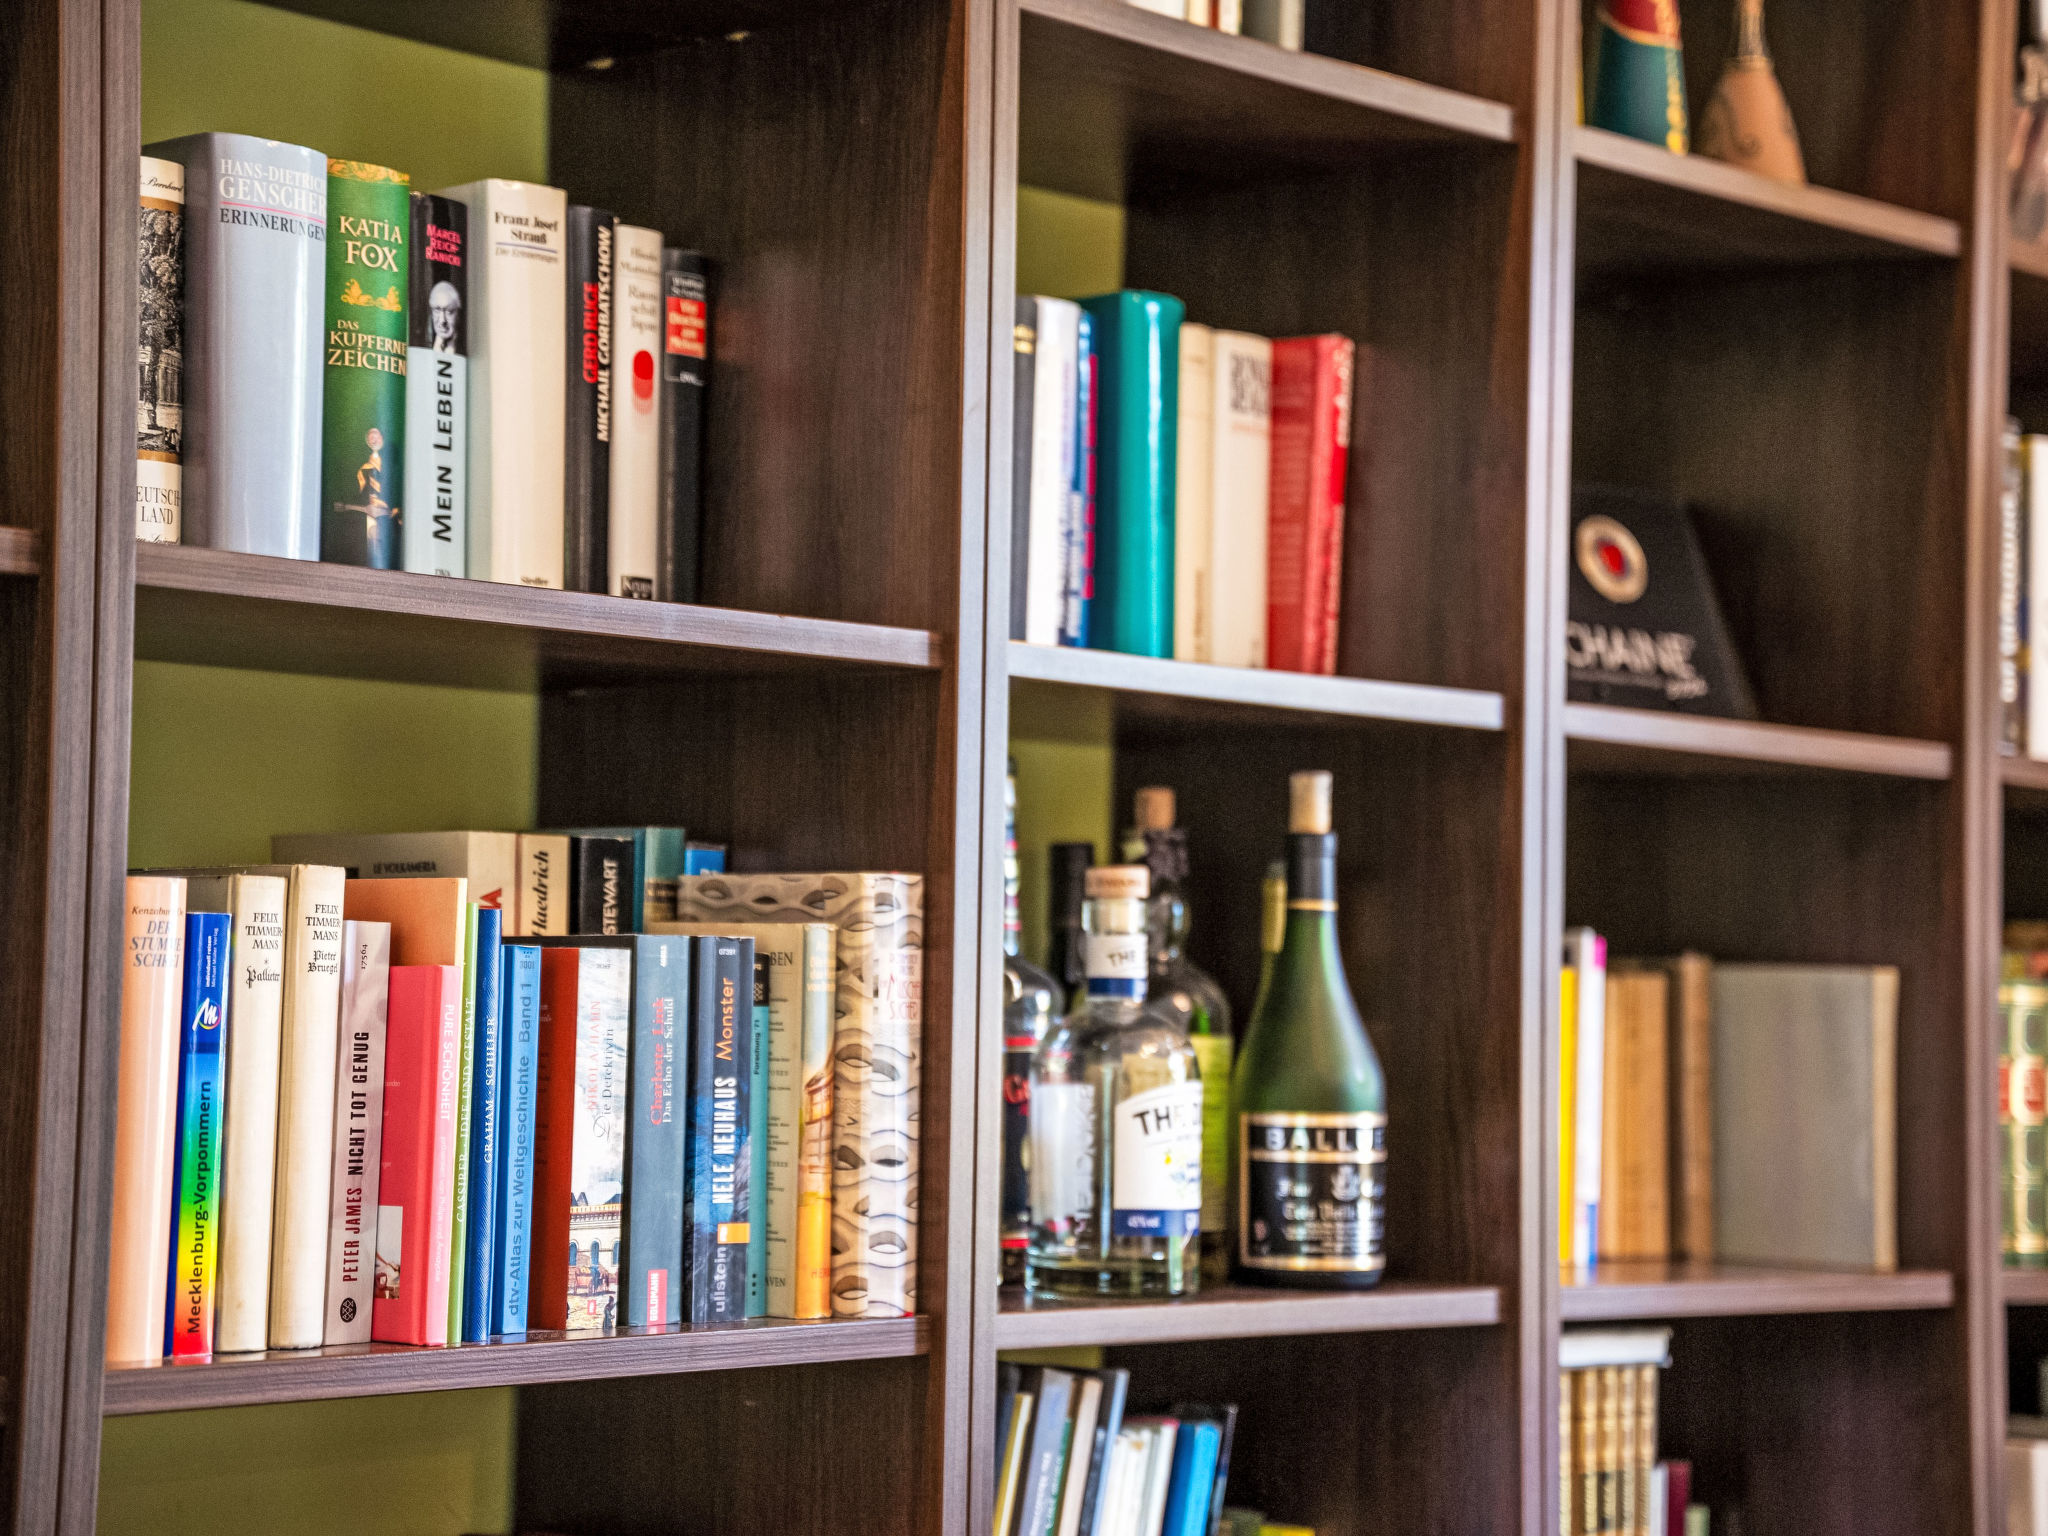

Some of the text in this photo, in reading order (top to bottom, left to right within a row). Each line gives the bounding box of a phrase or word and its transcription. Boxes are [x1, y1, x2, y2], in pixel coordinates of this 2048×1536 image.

[219, 176, 327, 217] GENSCHER
[219, 207, 326, 242] ERINNERUNGEN
[339, 215, 403, 244] KATIA
[426, 223, 461, 245] MARCEL
[494, 211, 559, 232] Franz Josef
[510, 229, 547, 245] Strauß
[345, 240, 398, 272] FOX
[330, 330, 407, 357] KUPFERNE
[337, 319, 359, 335] DAS
[583, 281, 599, 384] GERD RUGE
[597, 226, 612, 442] MICHAIL GORBATSCHOW
[328, 348, 406, 376] ZEICHEN
[433, 358, 454, 542] MEIN LEBEN
[136, 485, 180, 507] EUTSCH
[141, 505, 174, 525] LAND
[131, 905, 174, 916] Kenzabur
[315, 904, 339, 915] FELIX
[602, 856, 619, 936] STEWART
[253, 912, 279, 924] FELIX
[312, 930, 338, 941] MANS
[129, 936, 182, 951] STUME
[252, 939, 279, 950] MANS
[313, 950, 337, 963] Pieter
[769, 951, 793, 966] BEN
[715, 977, 735, 1061] Monster
[440, 1004, 455, 1120] PURE SCHÖNHEIT
[586, 1000, 600, 1110] NIKOLA HAHN
[602, 1028, 614, 1098] Detektivin
[650, 997, 664, 1126] Charlotte Link
[662, 998, 675, 1124] Das Echo der Schuld
[347, 1031, 370, 1176] NICHT TOT GENUG
[484, 1014, 496, 1163] GRAHAM SCHILLER
[456, 998, 475, 1222] CASSIRER IDEE UND GESTALT
[1132, 1104, 1172, 1136] TH
[508, 983, 532, 1316] dtv-Atlas zur Weltgeschichte Band 1
[711, 1076, 738, 1204] NELE NEUHAUS
[187, 1080, 211, 1334] Mecklenburg-Vorpommern
[343, 1187, 362, 1282] PETER JAMES
[714, 1246, 727, 1313] ullstein
